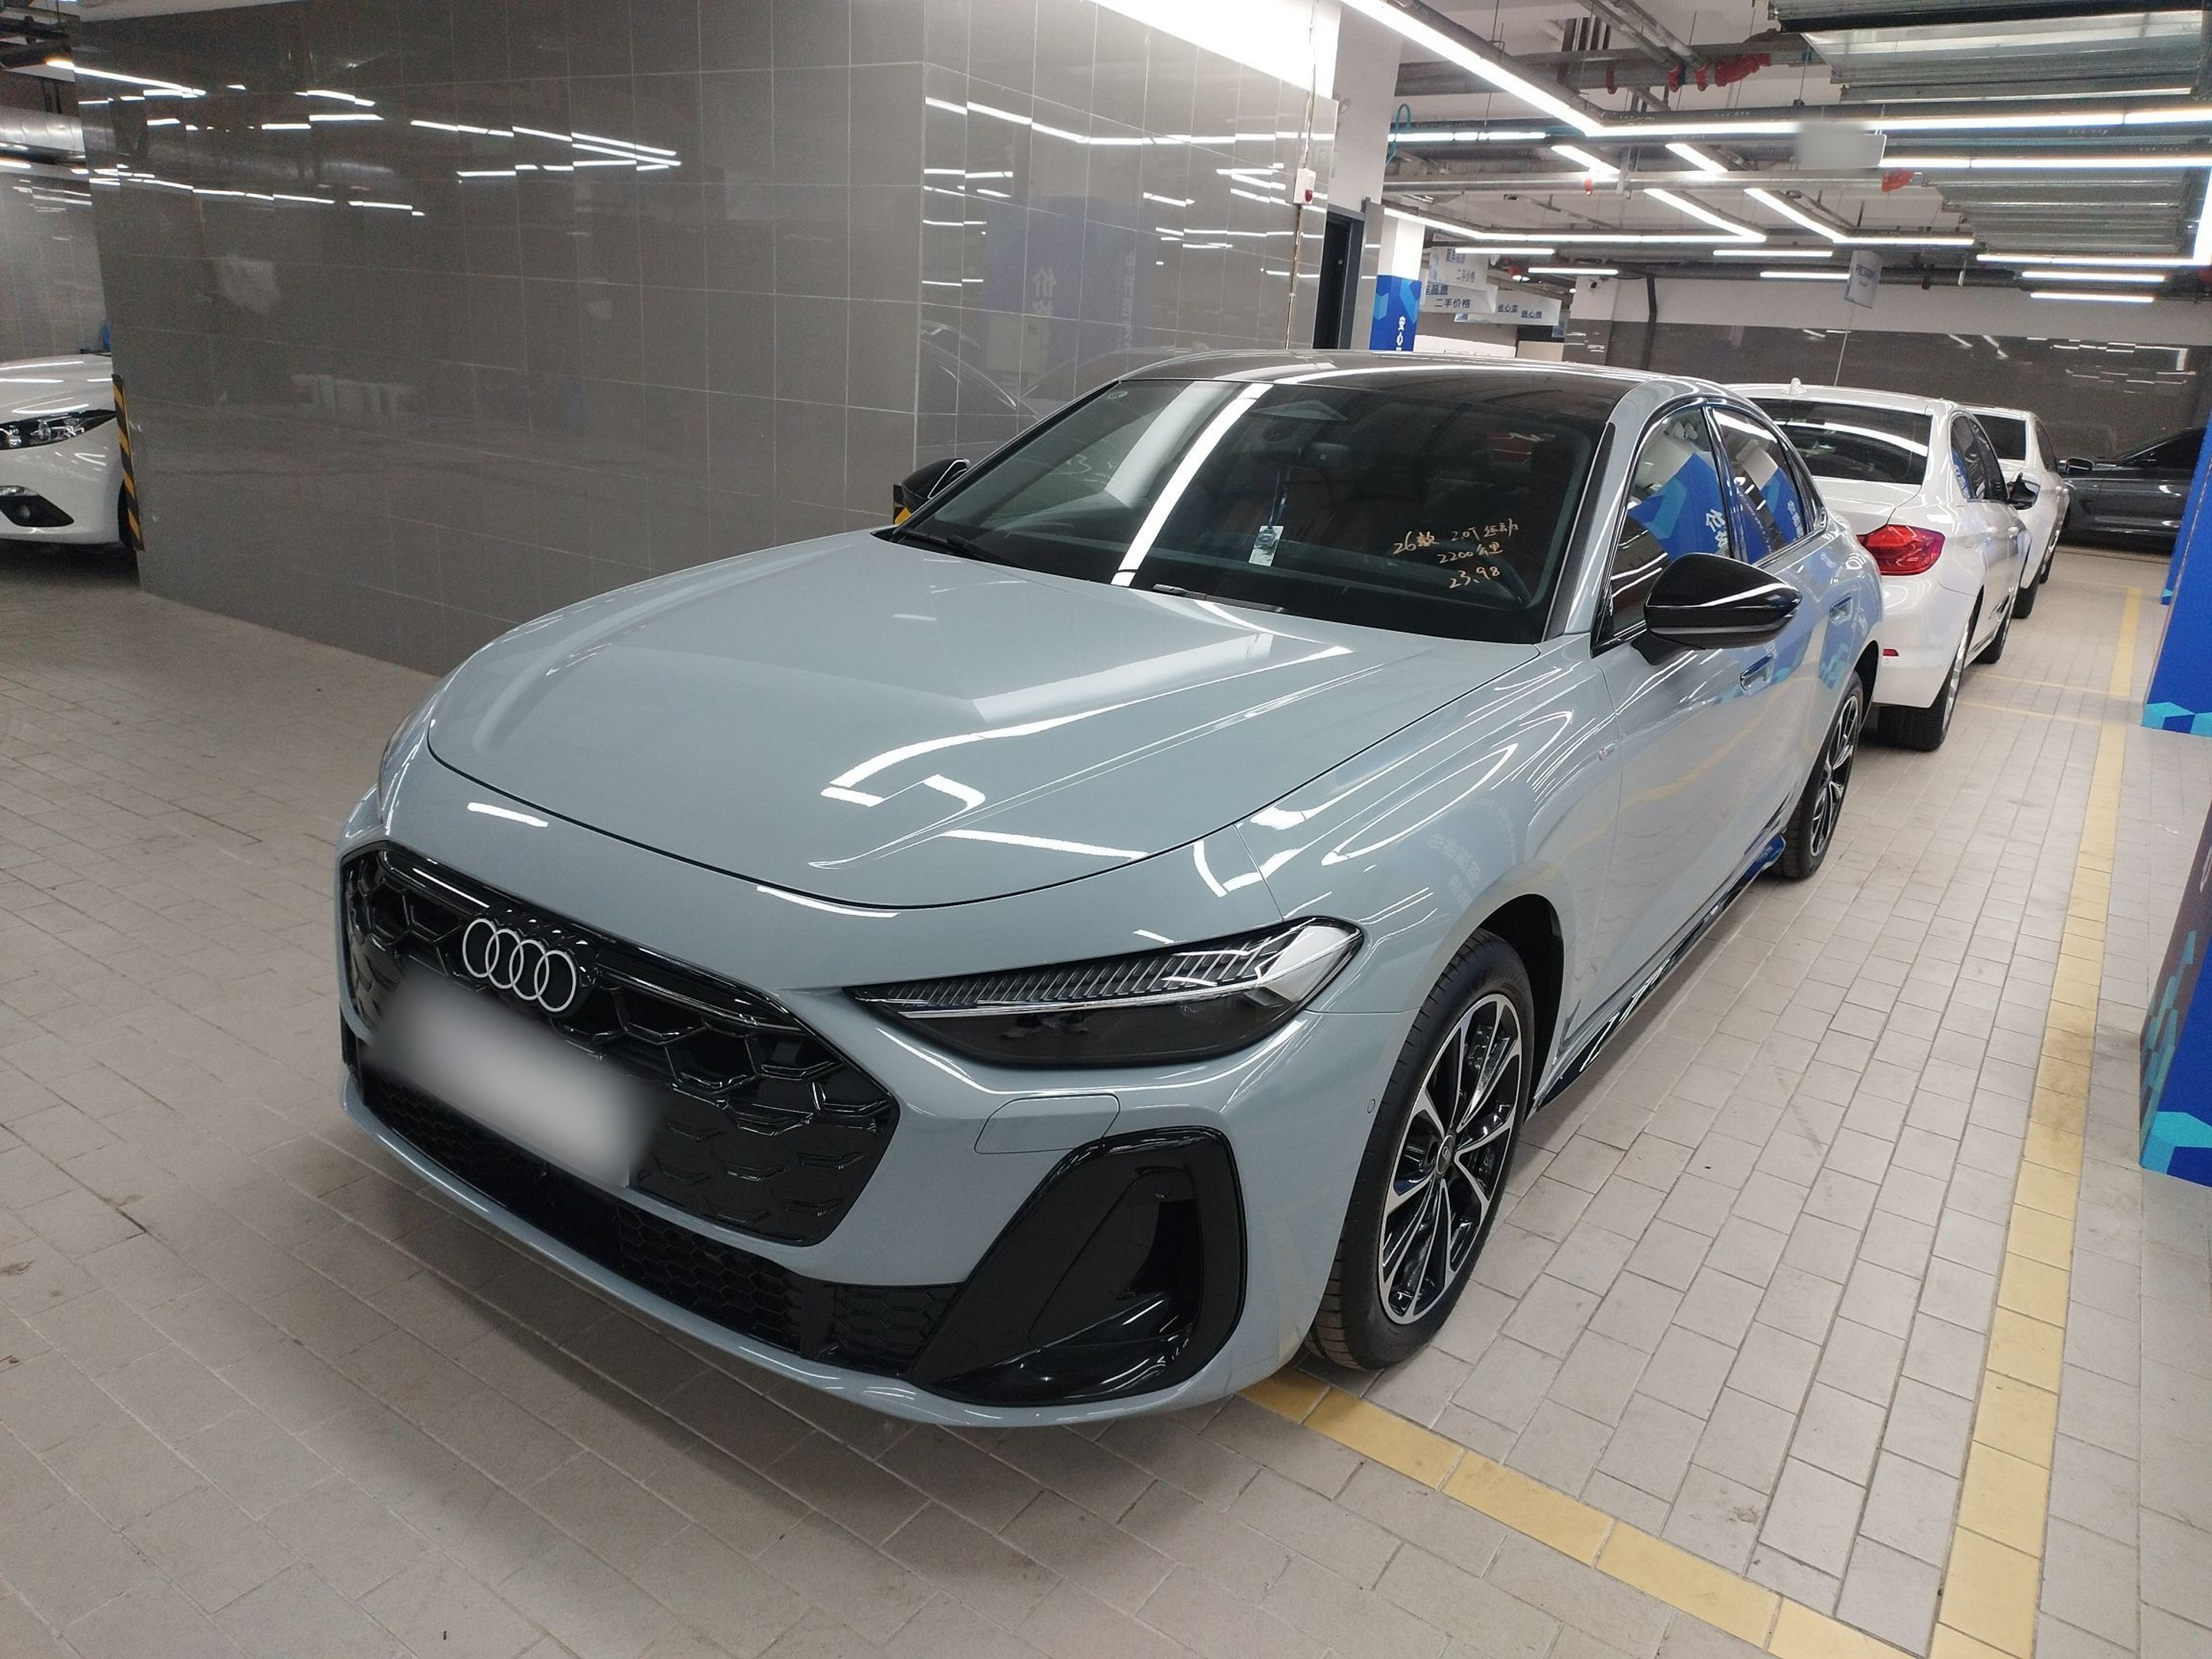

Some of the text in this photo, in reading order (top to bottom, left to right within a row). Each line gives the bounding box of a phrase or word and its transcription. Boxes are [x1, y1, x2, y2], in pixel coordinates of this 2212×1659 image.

[1434, 298, 1471, 309] 二手价格
[1395, 315, 1406, 351] 安心
[1392, 531, 1440, 555] 26款
[1449, 566, 1501, 589] 23.98
